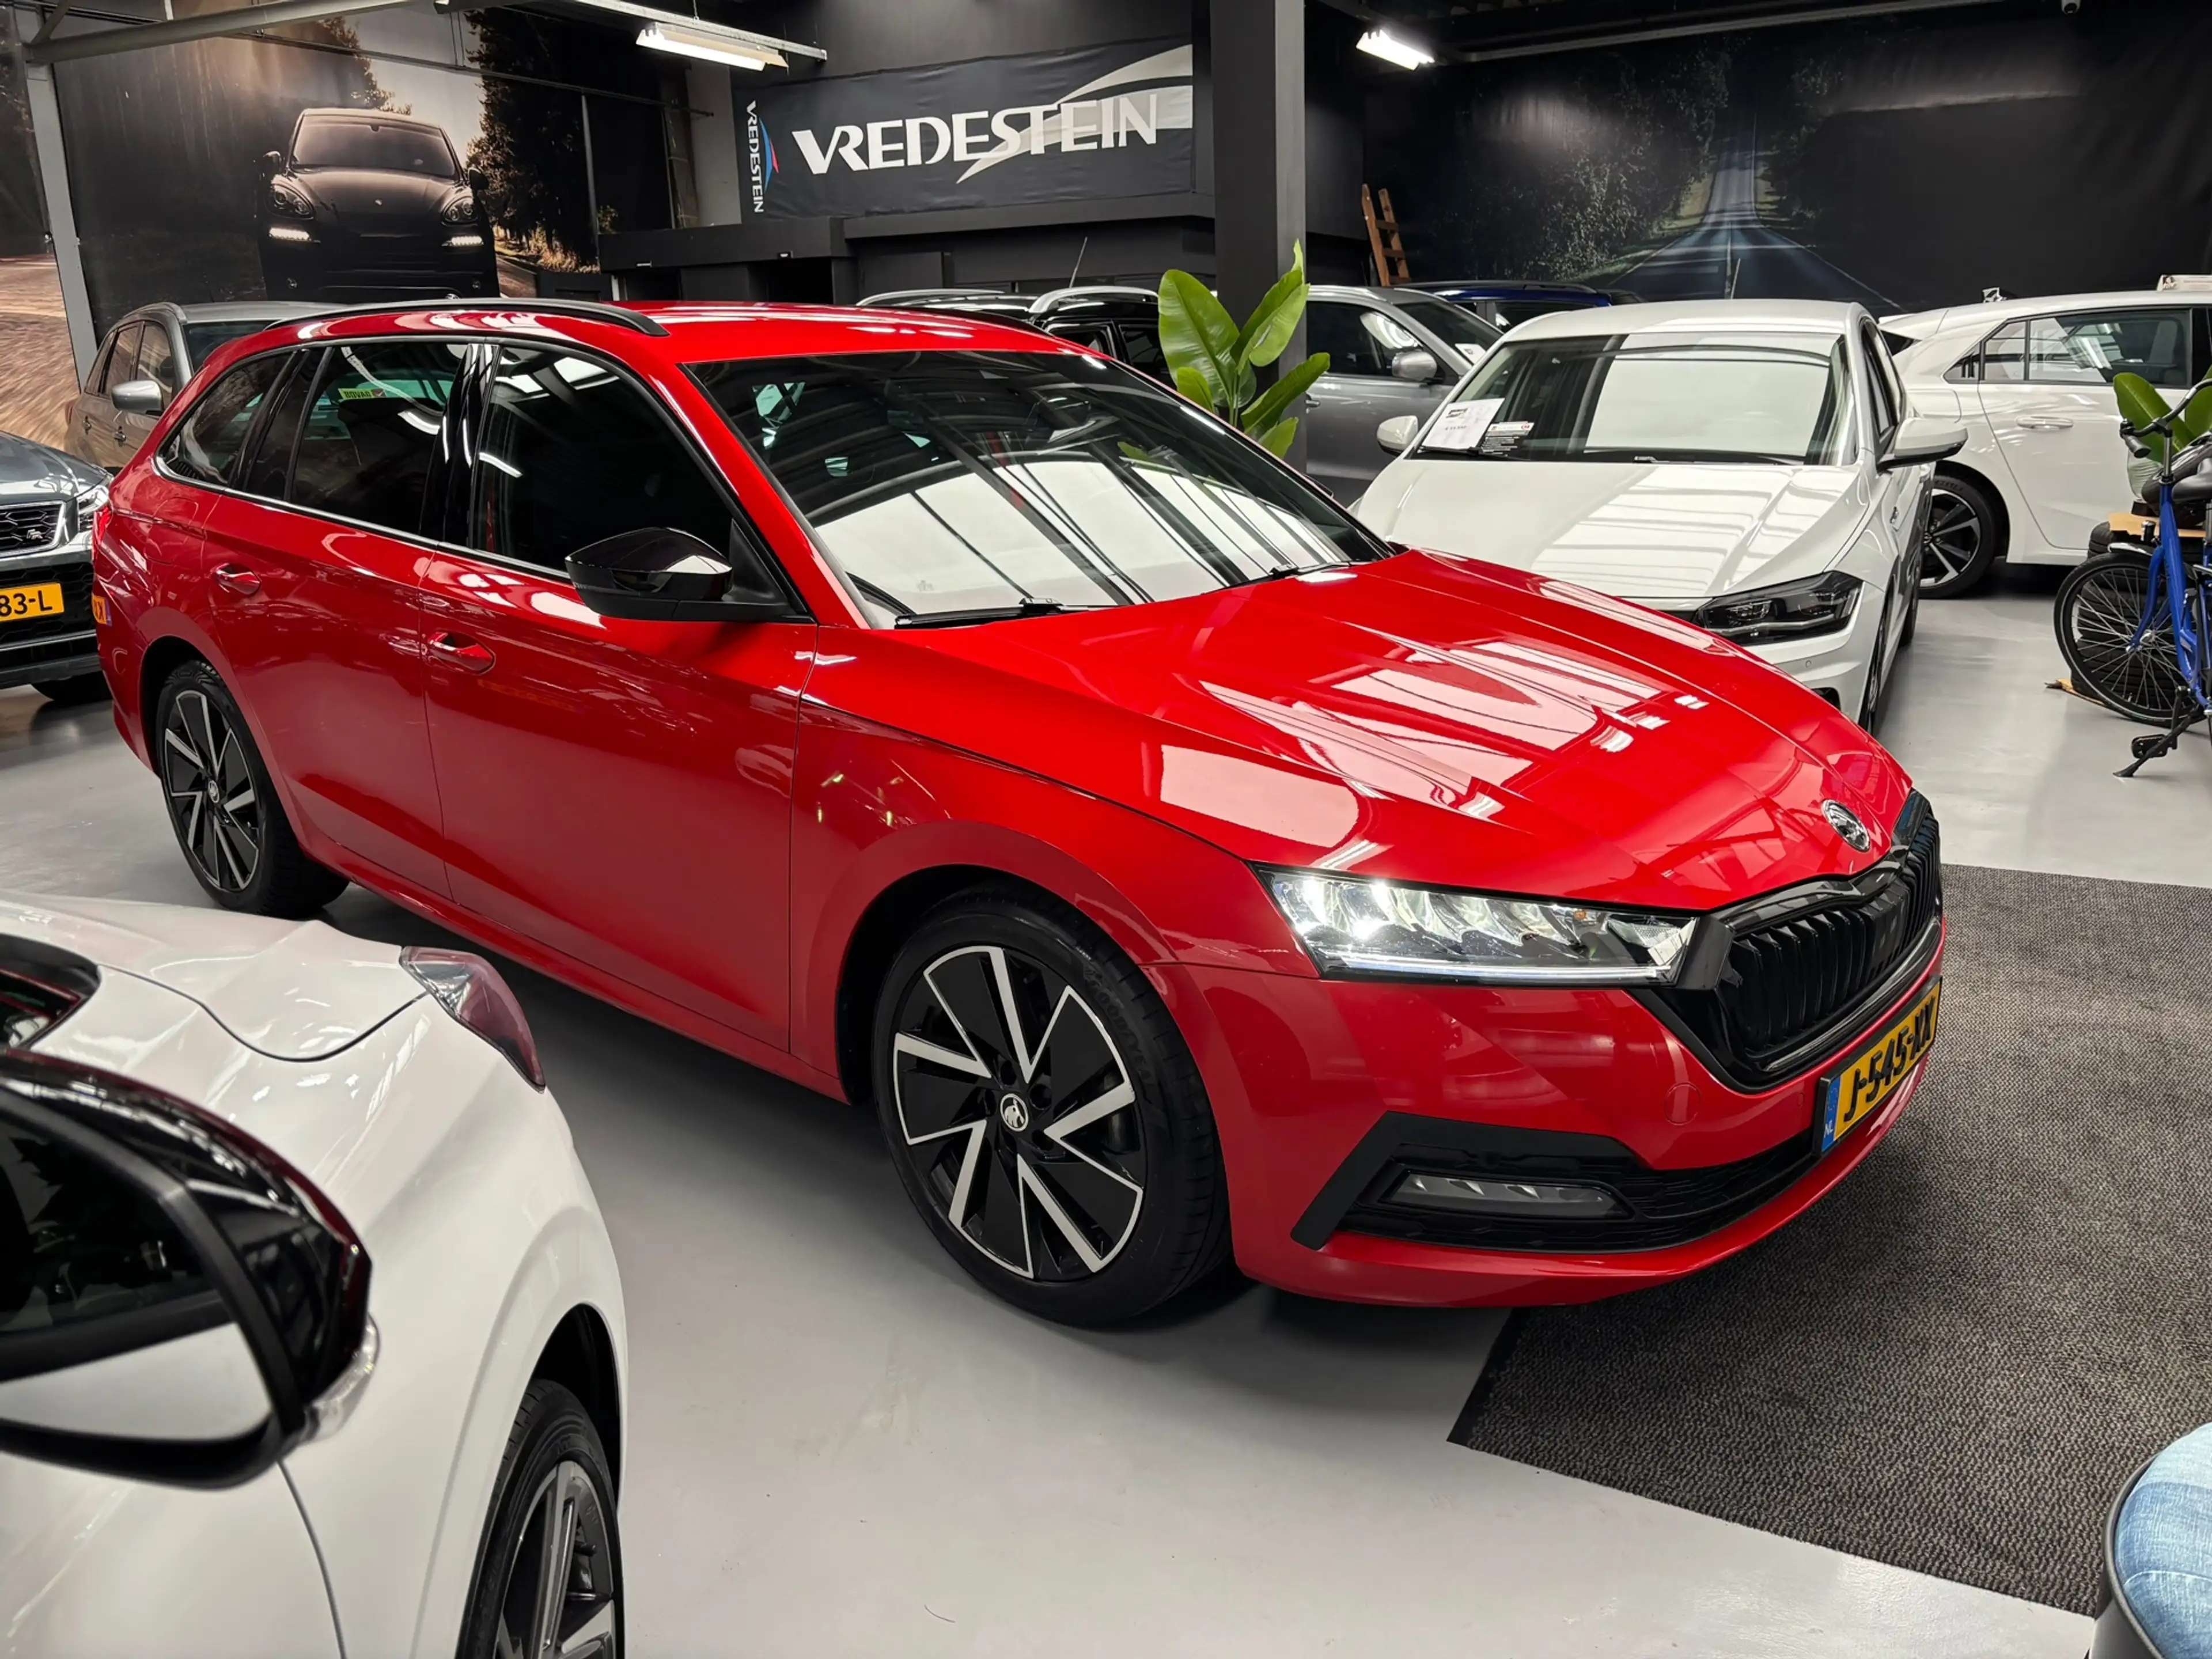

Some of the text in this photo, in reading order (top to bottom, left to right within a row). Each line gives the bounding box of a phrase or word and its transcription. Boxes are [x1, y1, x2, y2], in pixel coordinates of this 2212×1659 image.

[747, 100, 764, 213] VREDESTEIN
[792, 94, 1157, 175] VREDESTEIN
[0, 590, 52, 617] 83-L
[1086, 979, 1157, 1090] GOODYEA
[1824, 1120, 1834, 1136] NL
